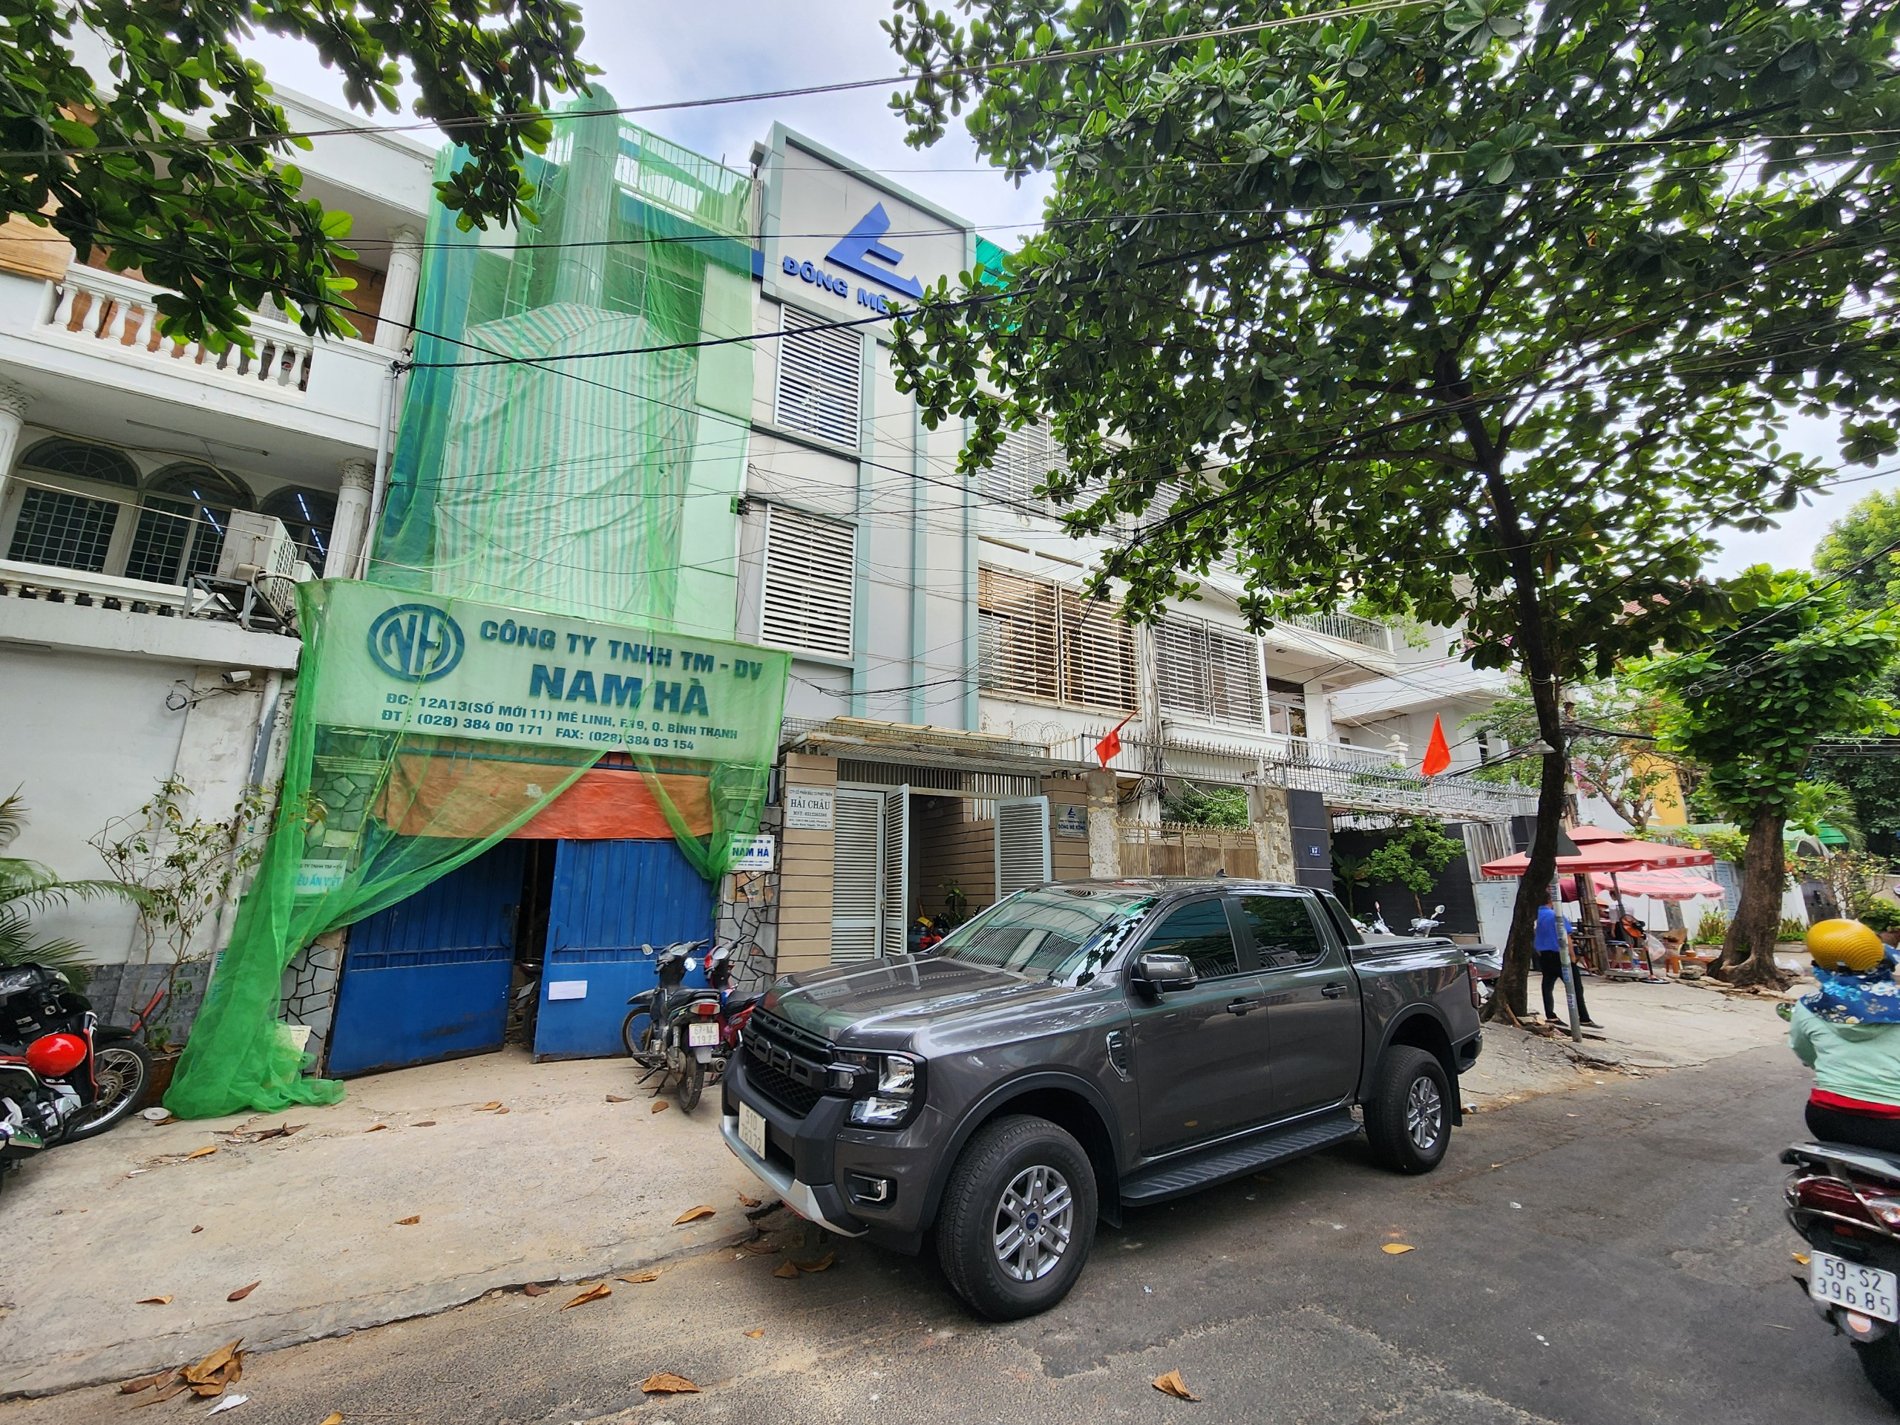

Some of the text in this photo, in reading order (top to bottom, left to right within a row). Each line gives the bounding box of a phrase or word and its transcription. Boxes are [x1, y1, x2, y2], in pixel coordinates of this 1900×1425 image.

[783, 255, 888, 314] ĐÔNG MÊ
[480, 619, 556, 650] CÔNG
[567, 633, 598, 656] TY
[609, 640, 672, 667] TNHH
[681, 651, 714, 673] TM
[529, 664, 709, 717] NAM HÀ
[386, 693, 413, 705] ĐC:
[498, 705, 526, 718] MỚI
[530, 709, 552, 721] 11)
[557, 711, 578, 723] MÊ
[652, 722, 663, 732] Q.
[667, 722, 697, 735] BÌNH
[700, 726, 738, 739] THẠNH
[417, 713, 458, 728] (028)
[463, 718, 490, 730] 384
[495, 721, 513, 732] 00
[518, 724, 542, 735] 171
[556, 728, 583, 740] FAX:
[589, 731, 622, 744] (028)
[627, 735, 649, 746] 384
[653, 738, 668, 747] 03
[672, 739, 694, 750] 154
[732, 846, 769, 857] NAM HÀ
[1825, 1258, 1882, 1292] 59-S2
